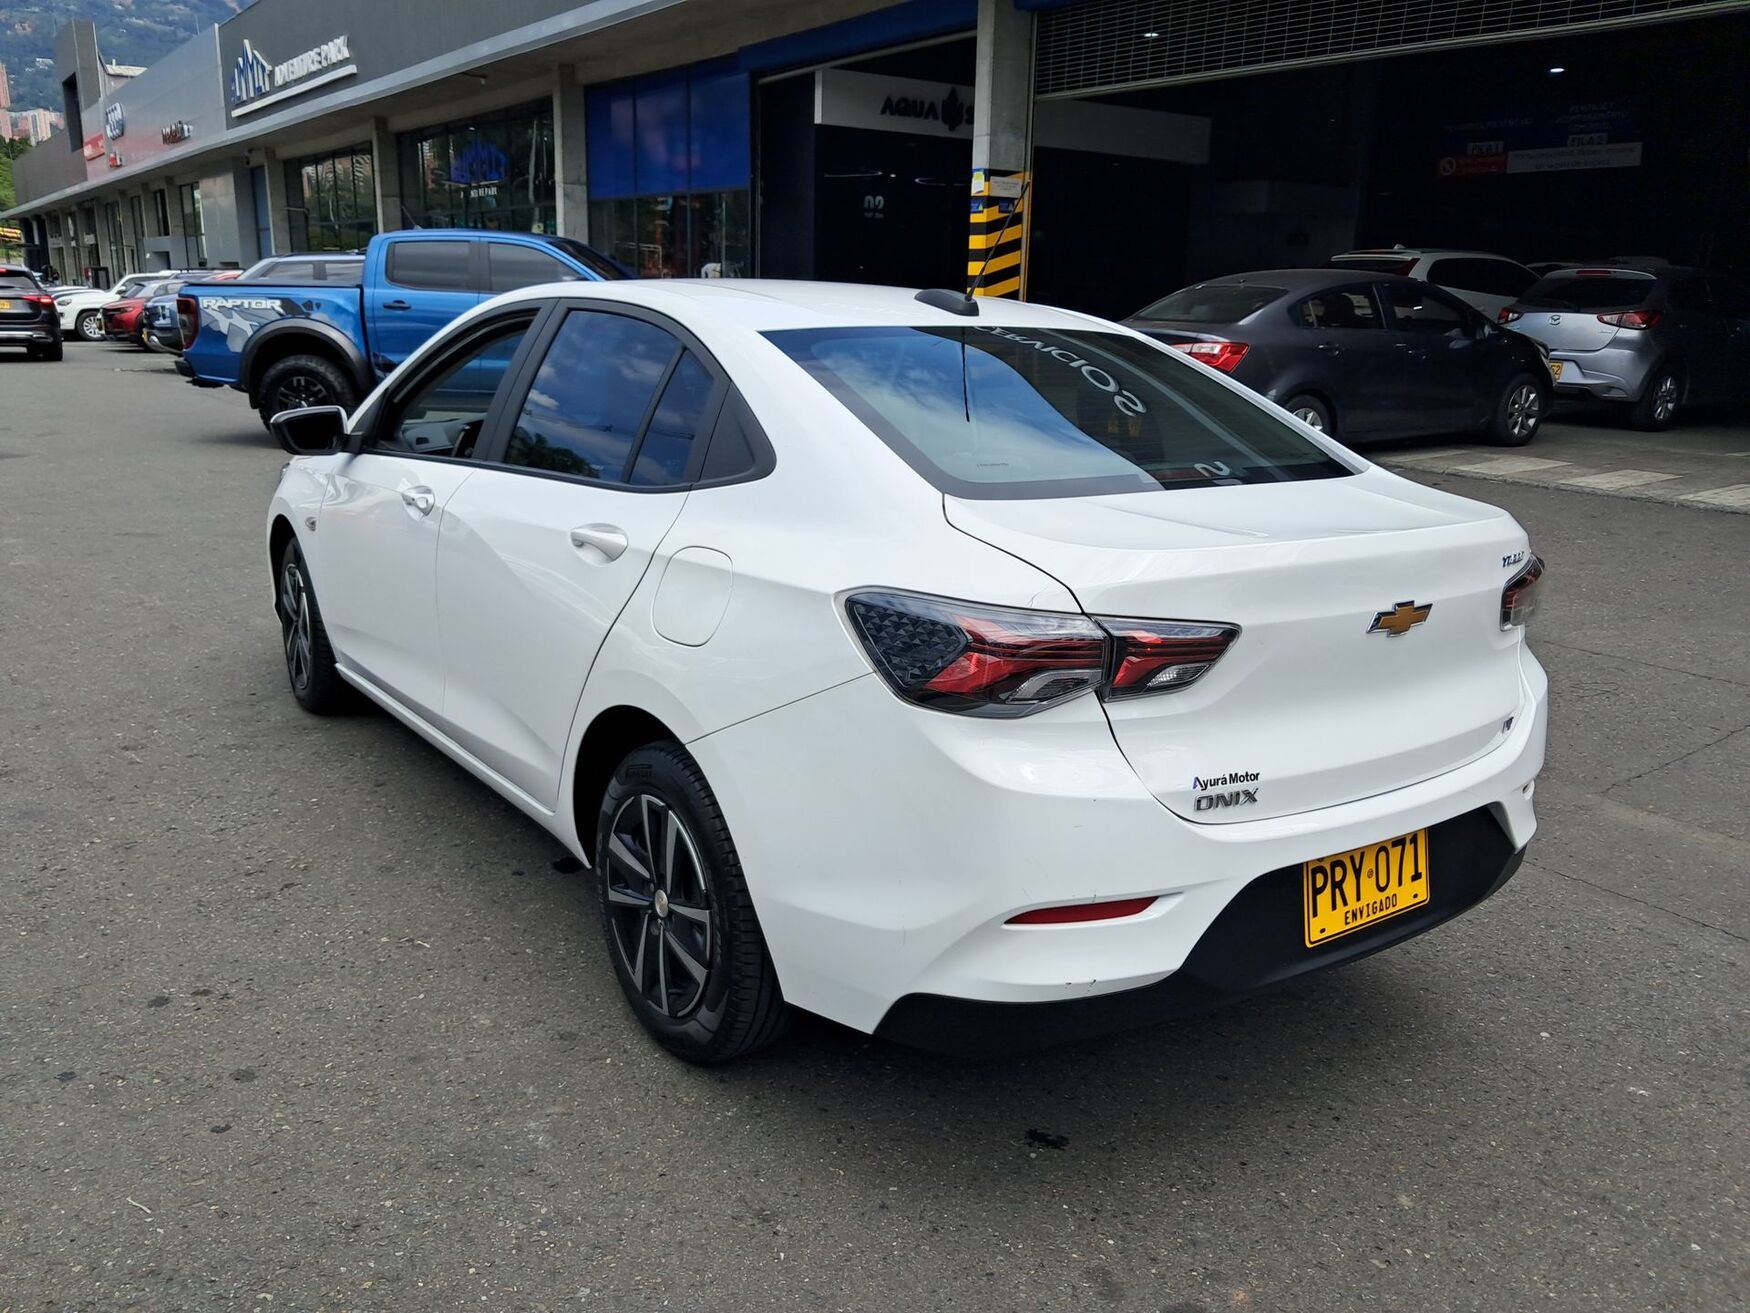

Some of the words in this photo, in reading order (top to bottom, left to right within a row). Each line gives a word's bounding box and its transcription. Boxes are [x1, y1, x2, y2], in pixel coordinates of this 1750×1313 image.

[880, 97, 939, 120] AQUA
[202, 298, 286, 316] RAPTOR
[1193, 774, 1228, 791] Ayurá
[1229, 771, 1260, 784] Motor
[1194, 787, 1259, 811] ONIX
[1344, 893, 1398, 926] ENVIGADO
